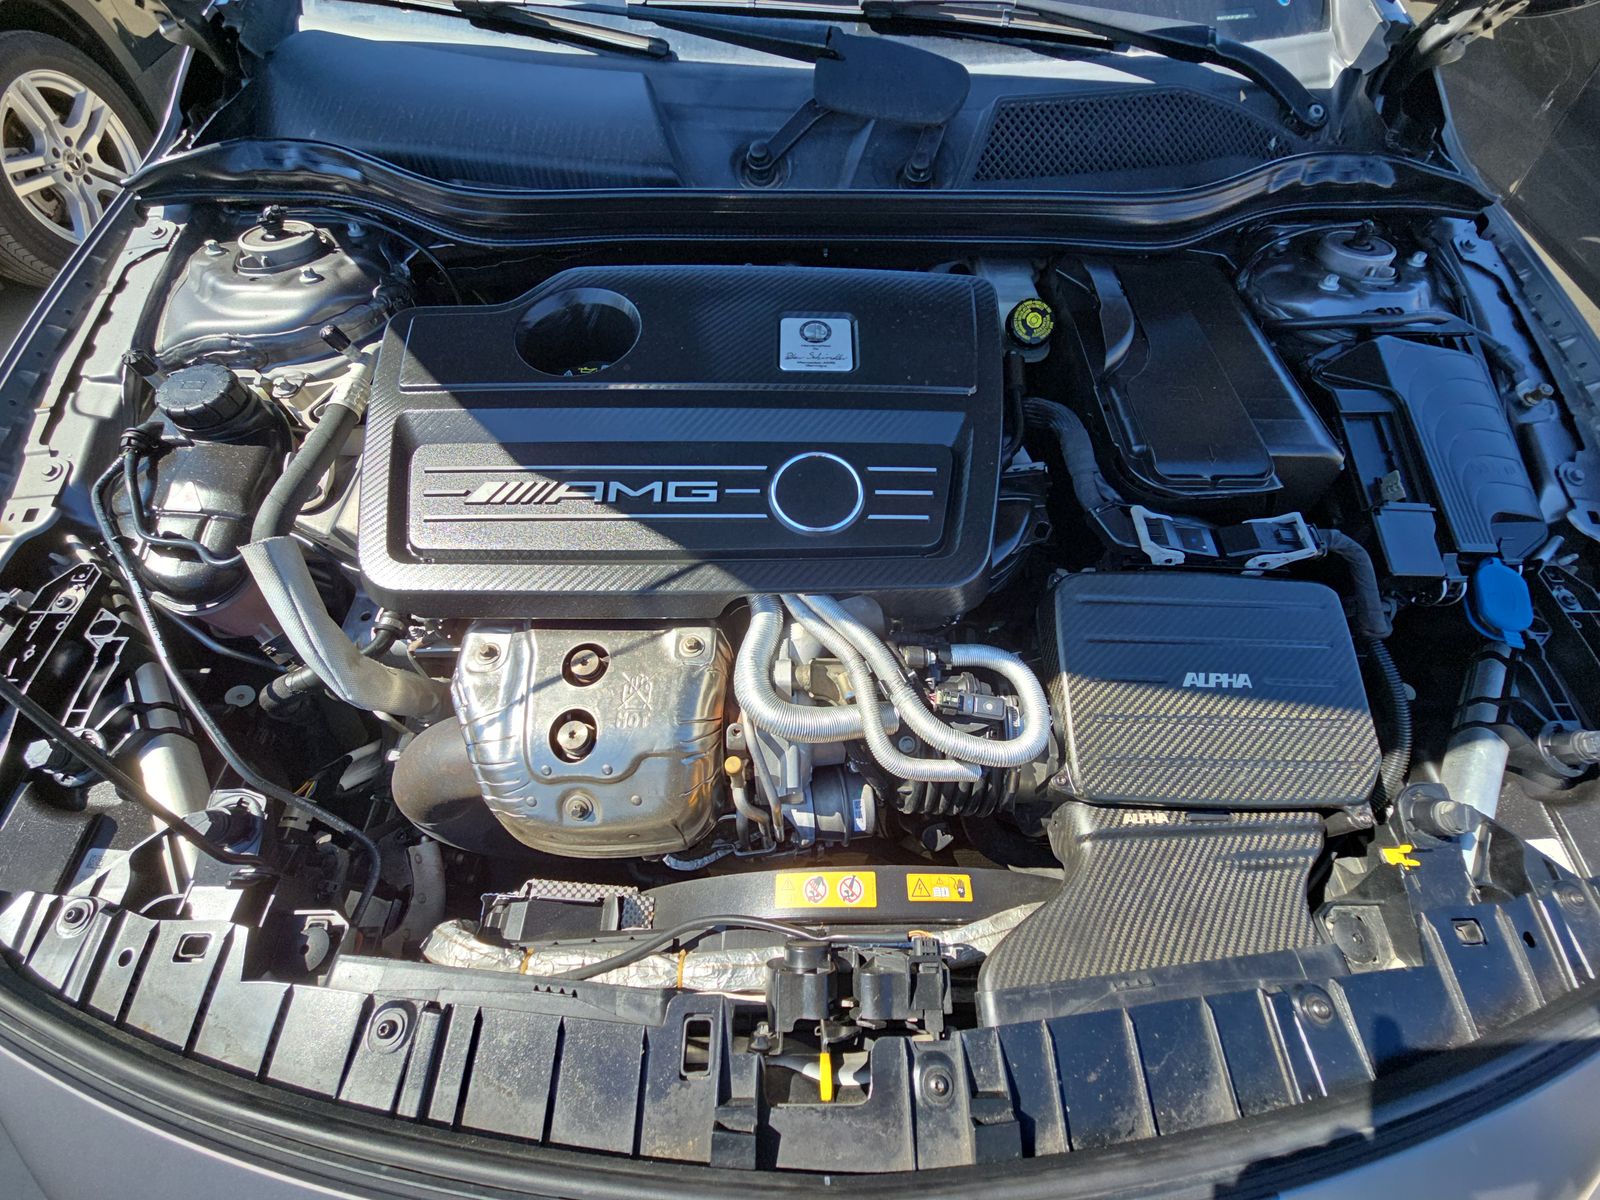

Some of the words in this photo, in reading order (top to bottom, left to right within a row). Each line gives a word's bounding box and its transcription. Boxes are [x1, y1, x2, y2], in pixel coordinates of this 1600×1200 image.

[545, 481, 719, 504] AMG
[1182, 672, 1253, 689] ALPHA
[1122, 812, 1170, 825] ALPHA
